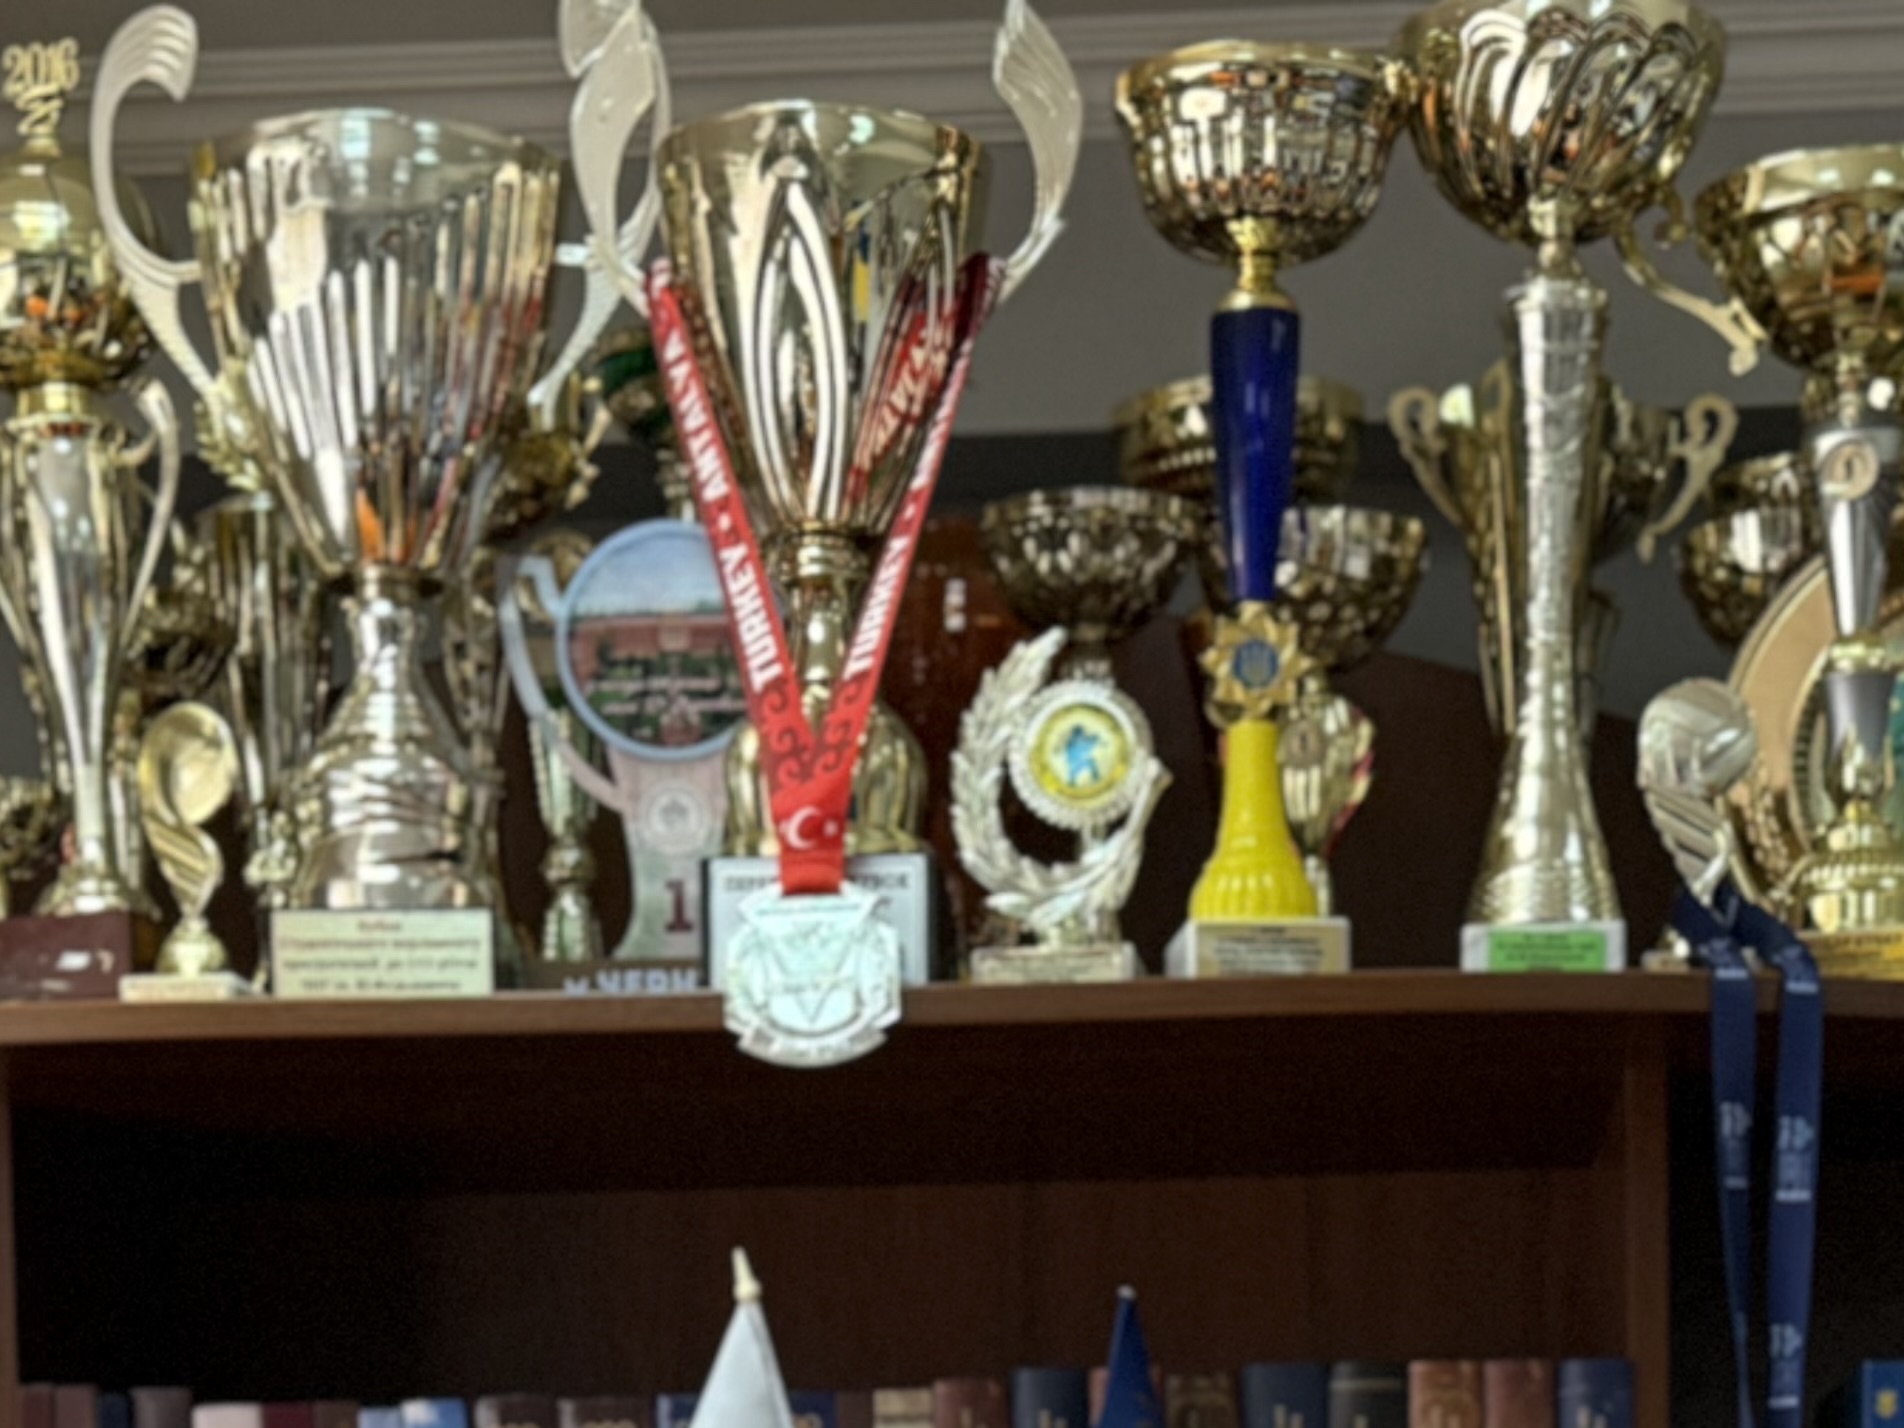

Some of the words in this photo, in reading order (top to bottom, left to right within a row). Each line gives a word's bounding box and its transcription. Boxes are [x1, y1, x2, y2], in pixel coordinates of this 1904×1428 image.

[660, 331, 730, 504] ANTALYA
[719, 543, 784, 694] TURKEY
[842, 534, 910, 681] TURKEY
